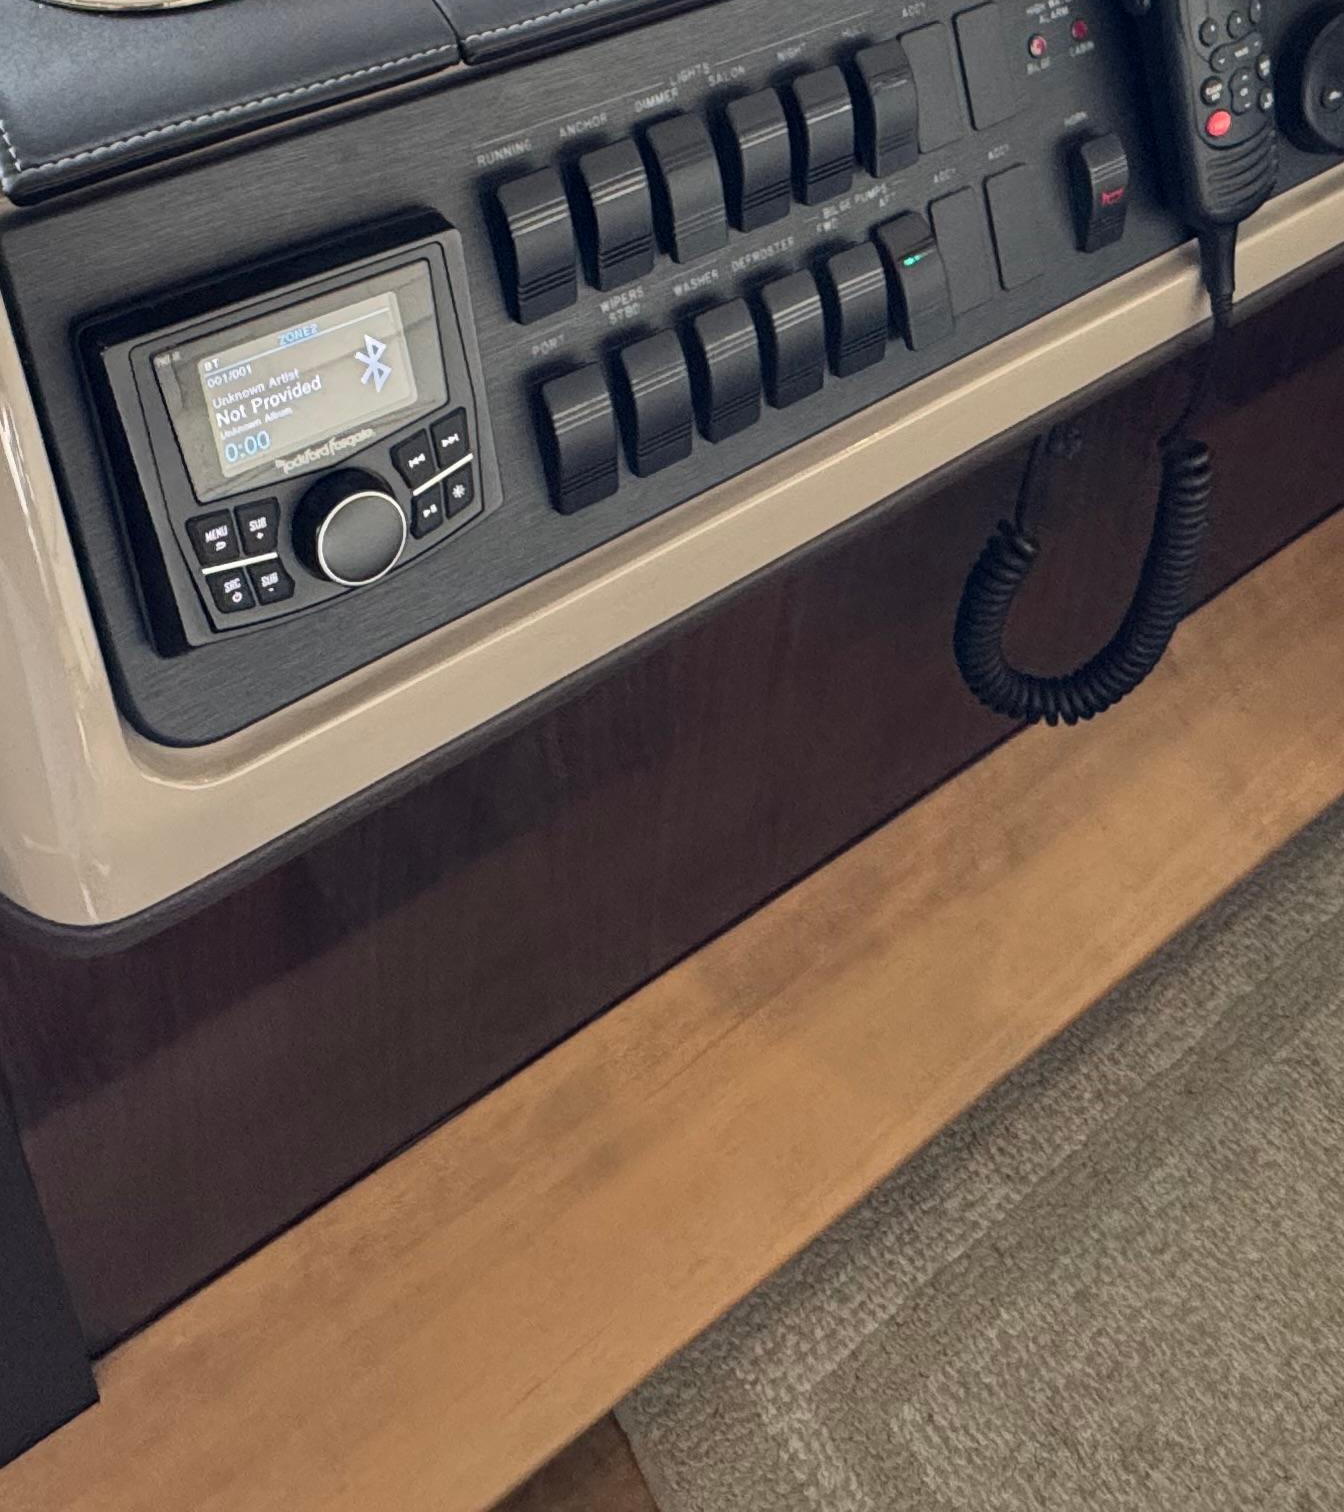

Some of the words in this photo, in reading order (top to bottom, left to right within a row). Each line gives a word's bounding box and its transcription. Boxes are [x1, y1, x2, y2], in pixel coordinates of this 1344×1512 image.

[669, 61, 711, 88] LIGHTS
[708, 64, 747, 89] SALON
[633, 86, 680, 114] DIMMER
[557, 111, 608, 139] ANCHOR
[475, 138, 533, 168] RUNNING
[729, 235, 796, 274] DEFROSTER
[672, 267, 720, 298] WASHER
[599, 284, 646, 315] WIPERS
[531, 333, 566, 357] PORT
[203, 357, 220, 372] BT
[206, 363, 253, 389] 001/001
[211, 381, 266, 410] Unknown
[268, 367, 301, 390] Artist
[214, 404, 248, 428] Not
[249, 374, 323, 415] Provided
[223, 429, 272, 465] 0:00
[204, 524, 229, 544] MENU
[248, 516, 268, 532] SUB
[223, 577, 242, 594] SRC
